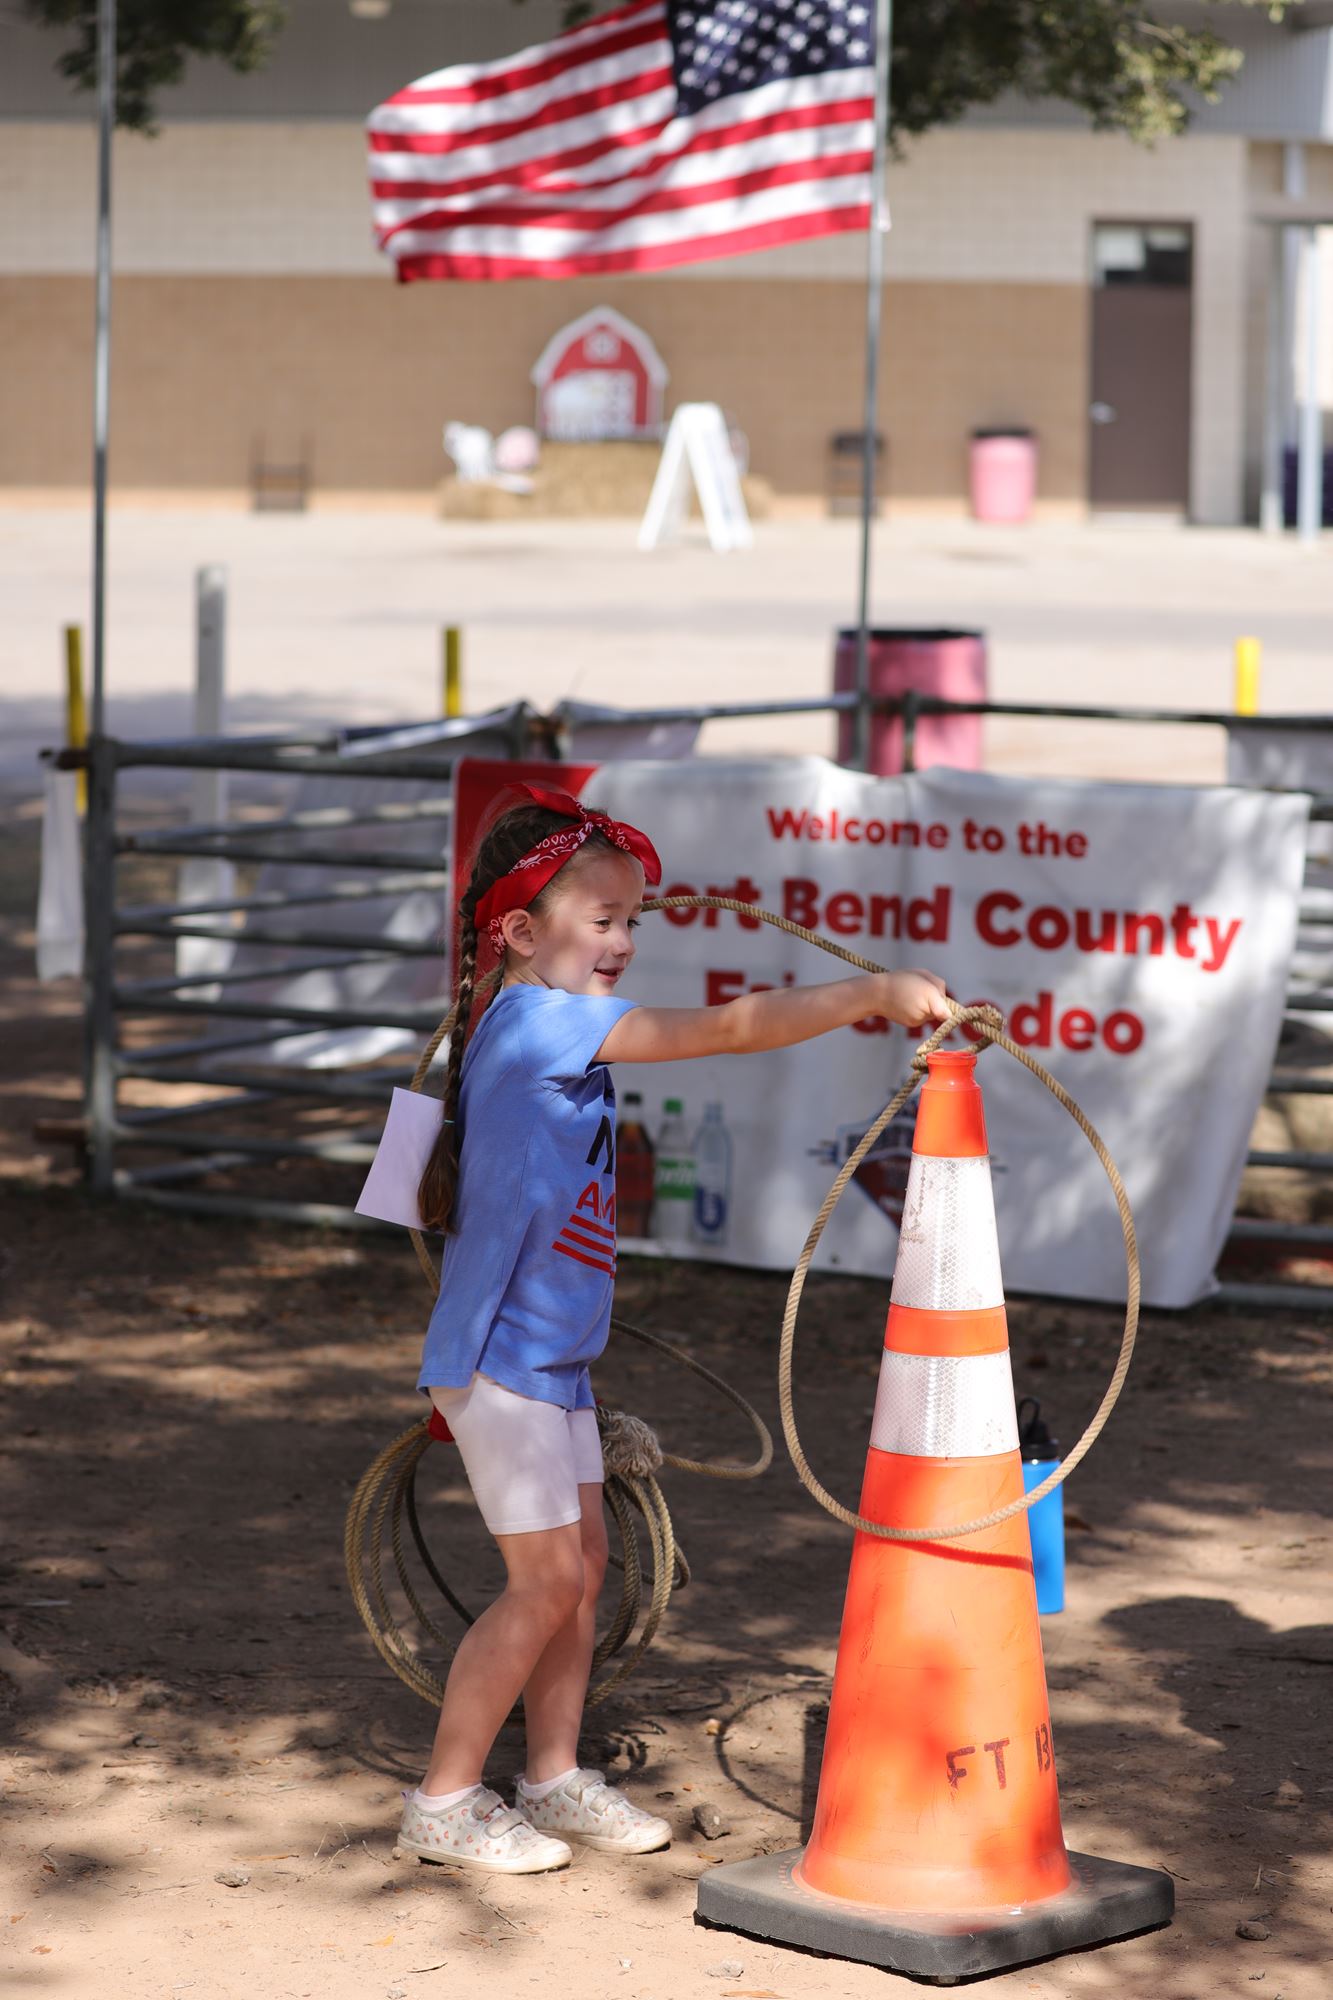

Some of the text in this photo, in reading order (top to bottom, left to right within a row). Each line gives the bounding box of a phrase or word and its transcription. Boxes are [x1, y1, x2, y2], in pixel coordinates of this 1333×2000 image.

[766, 807, 1089, 858] Welcome to the
[642, 876, 1242, 973] ort Bend County
[946, 1737, 1011, 1790] FT
